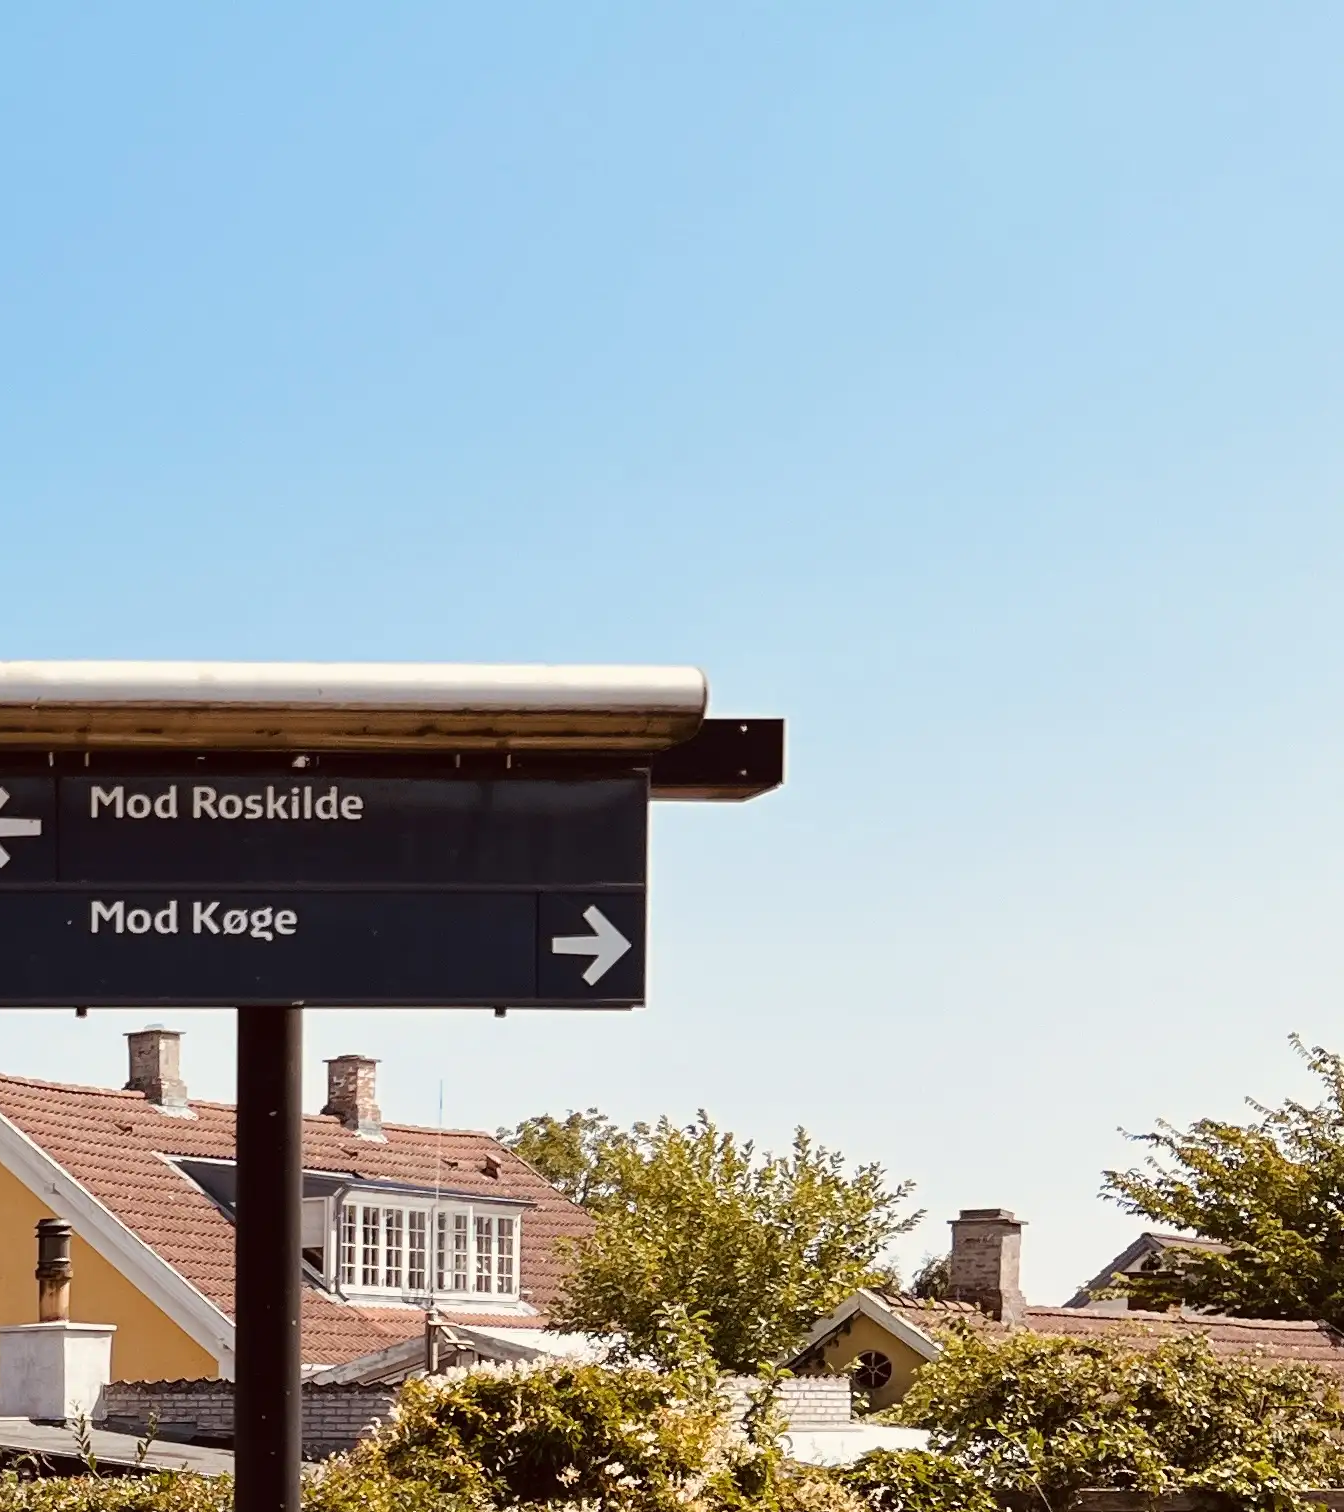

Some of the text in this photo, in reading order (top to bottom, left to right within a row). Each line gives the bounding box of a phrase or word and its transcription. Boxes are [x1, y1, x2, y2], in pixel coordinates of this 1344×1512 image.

[90, 785, 365, 820] Mod Roskilde
[90, 900, 299, 942] Mod Køge
